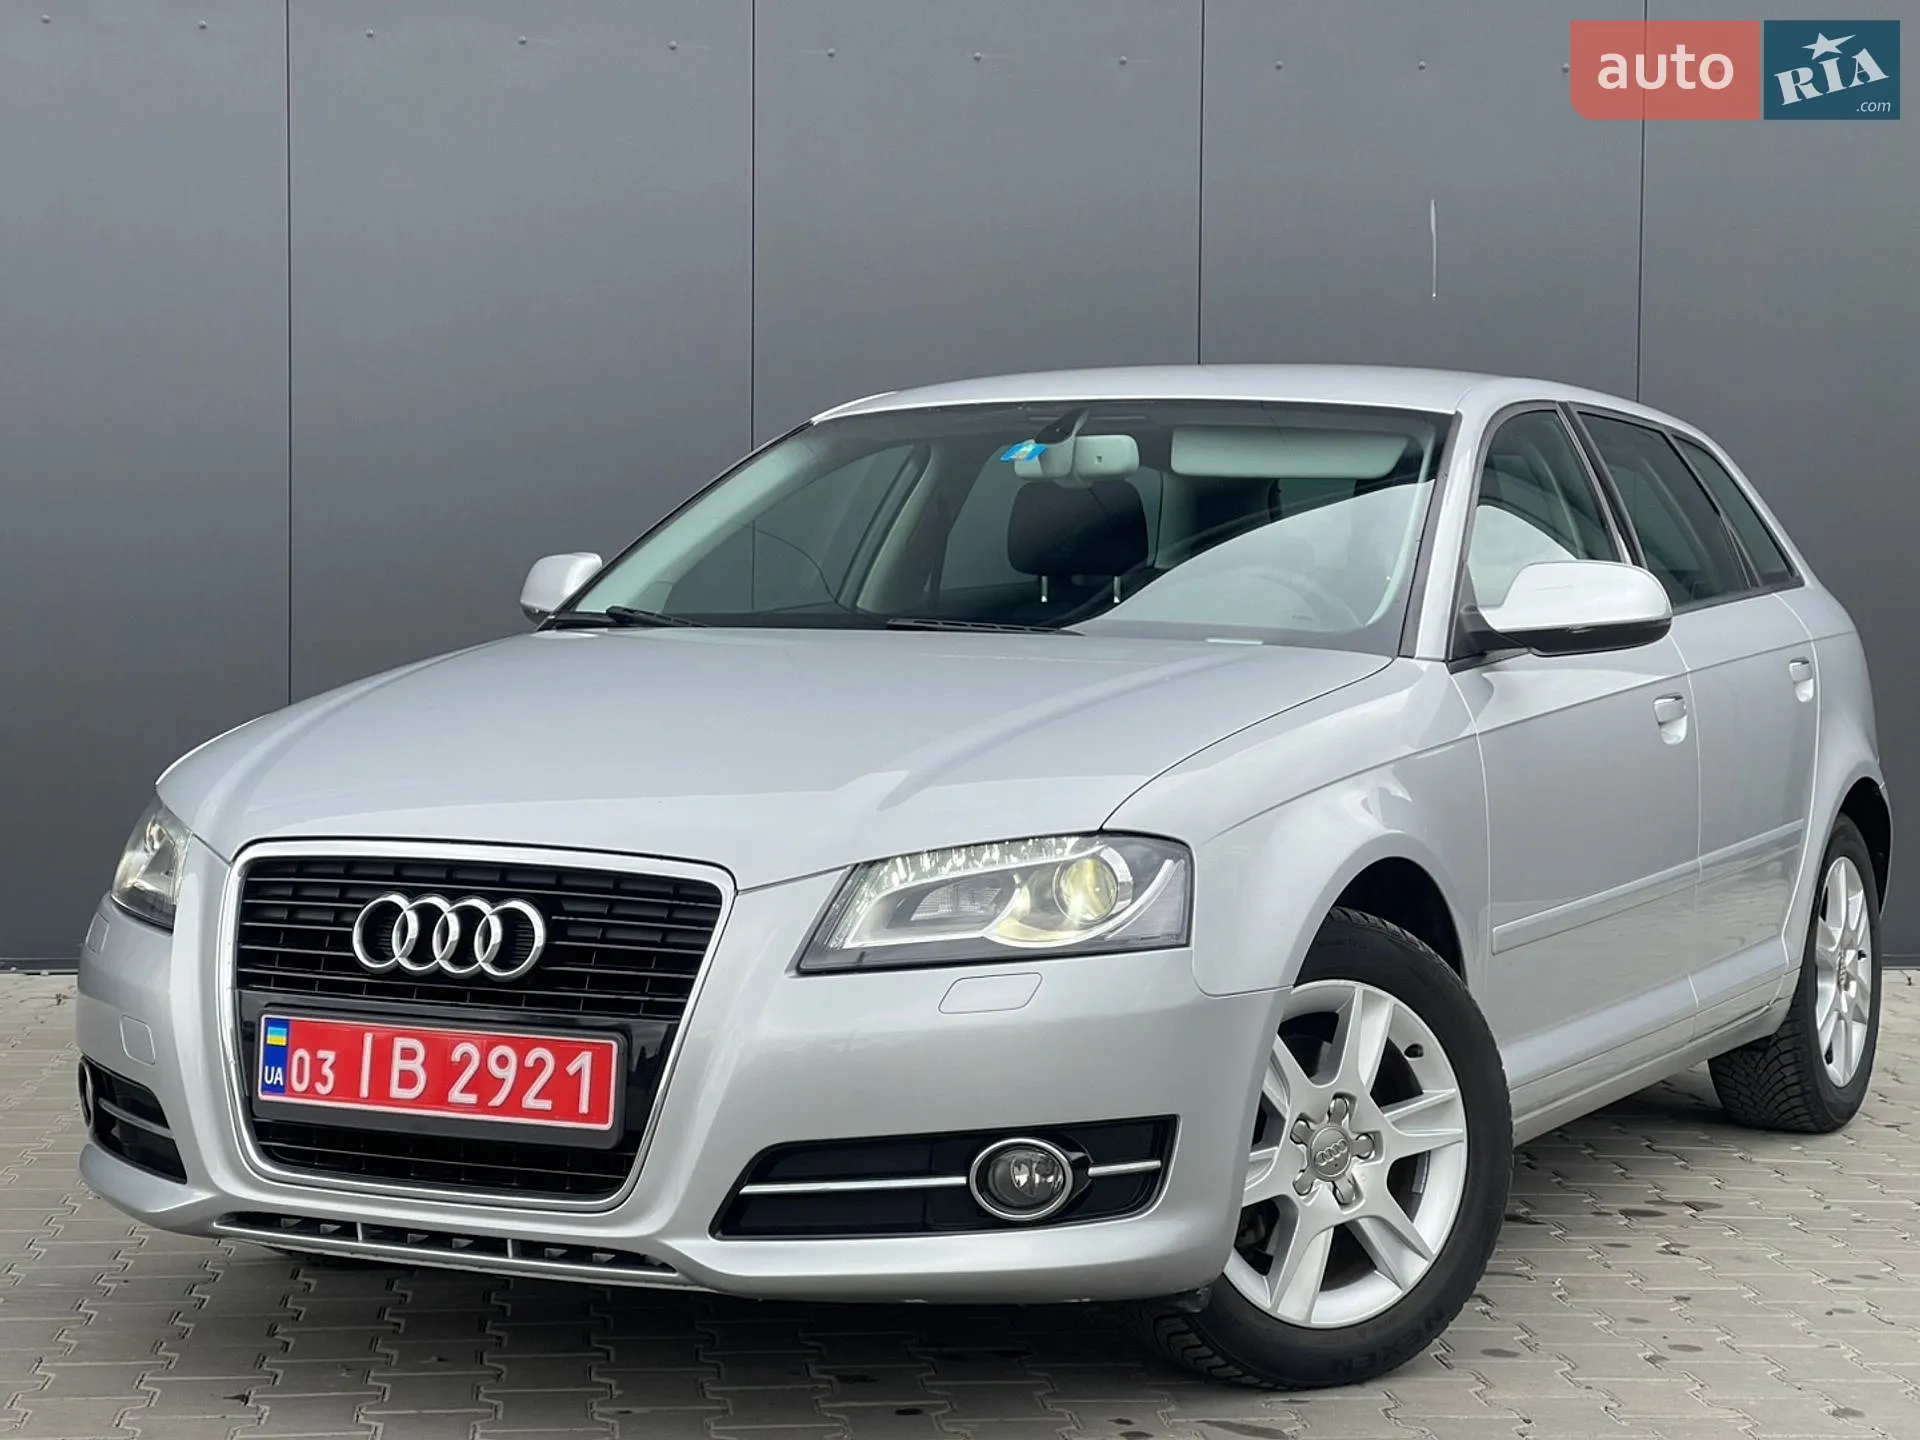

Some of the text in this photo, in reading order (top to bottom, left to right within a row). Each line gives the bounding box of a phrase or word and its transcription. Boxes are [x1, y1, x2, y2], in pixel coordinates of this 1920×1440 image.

[264, 1066, 283, 1086] UA
[290, 1048, 336, 1095] 03
[448, 1042, 592, 1114] 2921
[1331, 1308, 1446, 1374] NEXEN
